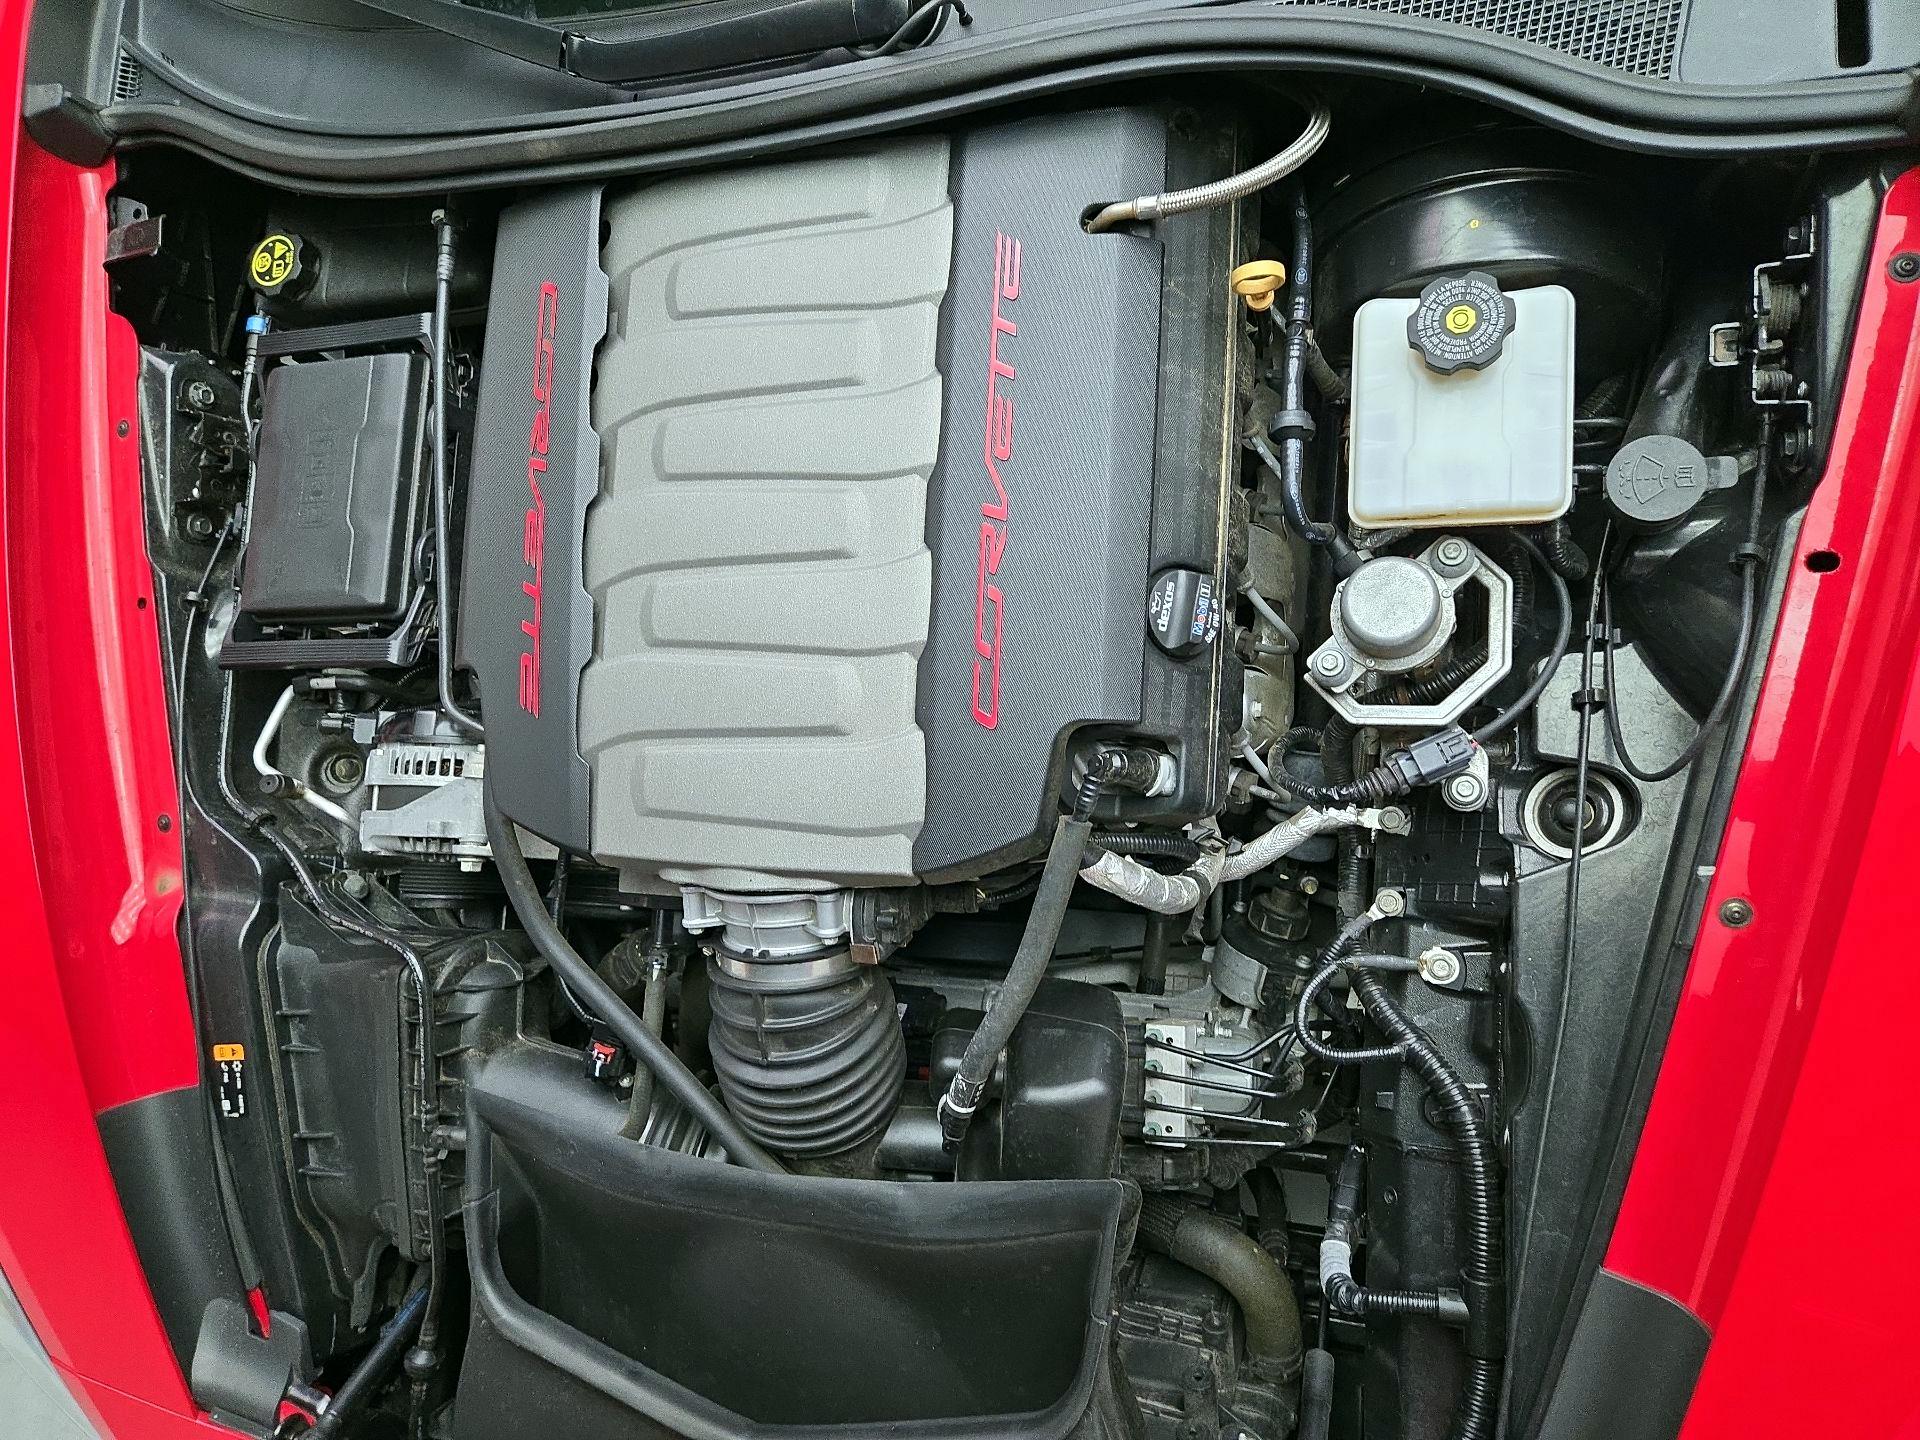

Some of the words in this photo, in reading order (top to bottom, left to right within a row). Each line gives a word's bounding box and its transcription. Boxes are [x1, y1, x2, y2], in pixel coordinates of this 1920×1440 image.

[1435, 290, 1451, 303] FREIN
[1467, 286, 1481, 296] ONLY
[1479, 291, 1490, 301] USE
[1418, 306, 1427, 330] BOUCHON
[1423, 291, 1438, 307] AVANT
[1436, 286, 1445, 294] LA
[1444, 280, 1466, 290] DEPOSE
[1430, 301, 1438, 309] DE
[1466, 293, 1484, 306] FILLER
[1493, 294, 1505, 313] SEALED
[1425, 309, 1434, 328] LIQUIDE
[1433, 304, 1444, 320] BIDON
[1479, 303, 1490, 319] CLEAN
[1495, 318, 1505, 332] FROM
[1429, 335, 1440, 345] QUE
[1437, 333, 1467, 346] PROVENANT
[1480, 324, 1496, 343] BEFORE
[1486, 331, 1501, 347] FLUID
[1471, 339, 1483, 348] CAP
[972, 230, 1023, 729] CORVETTE
[519, 282, 558, 719] CORVETTE
[1157, 580, 1174, 632] dexos
[1192, 597, 1209, 636] Mobil
[1205, 628, 1216, 644] SAE
